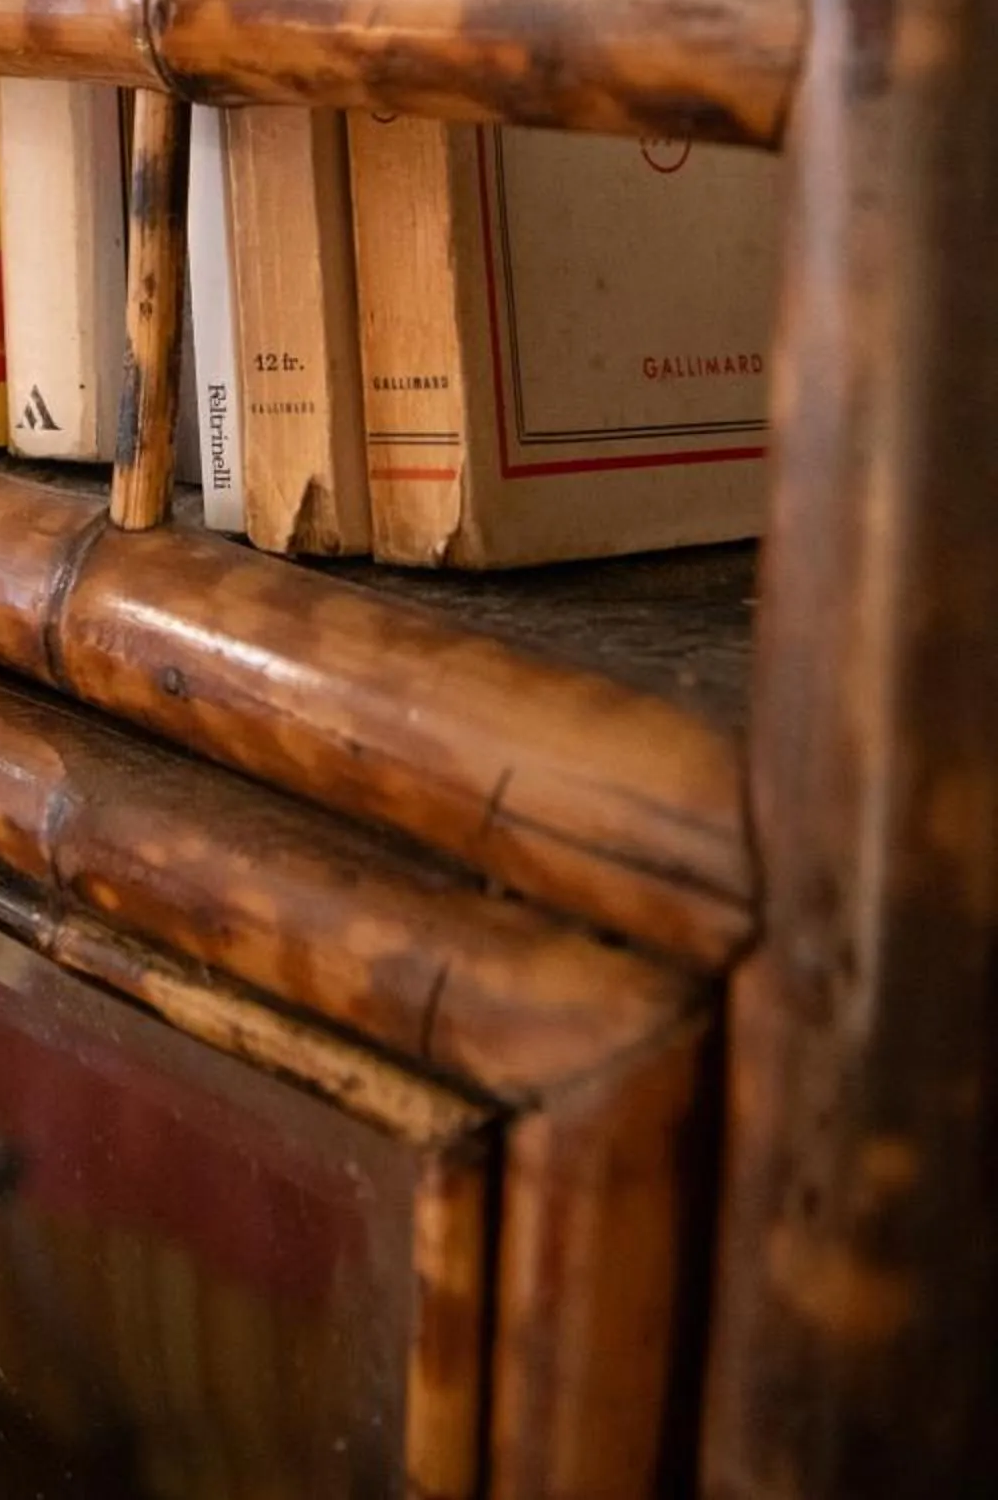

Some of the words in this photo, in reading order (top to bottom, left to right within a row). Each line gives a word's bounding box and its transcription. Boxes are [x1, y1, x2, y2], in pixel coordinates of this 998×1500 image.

[254, 353, 280, 372] 12
[642, 353, 765, 380] GALLIMARD
[372, 375, 450, 392] GALLIMARD
[207, 384, 232, 491] Feltrinelli
